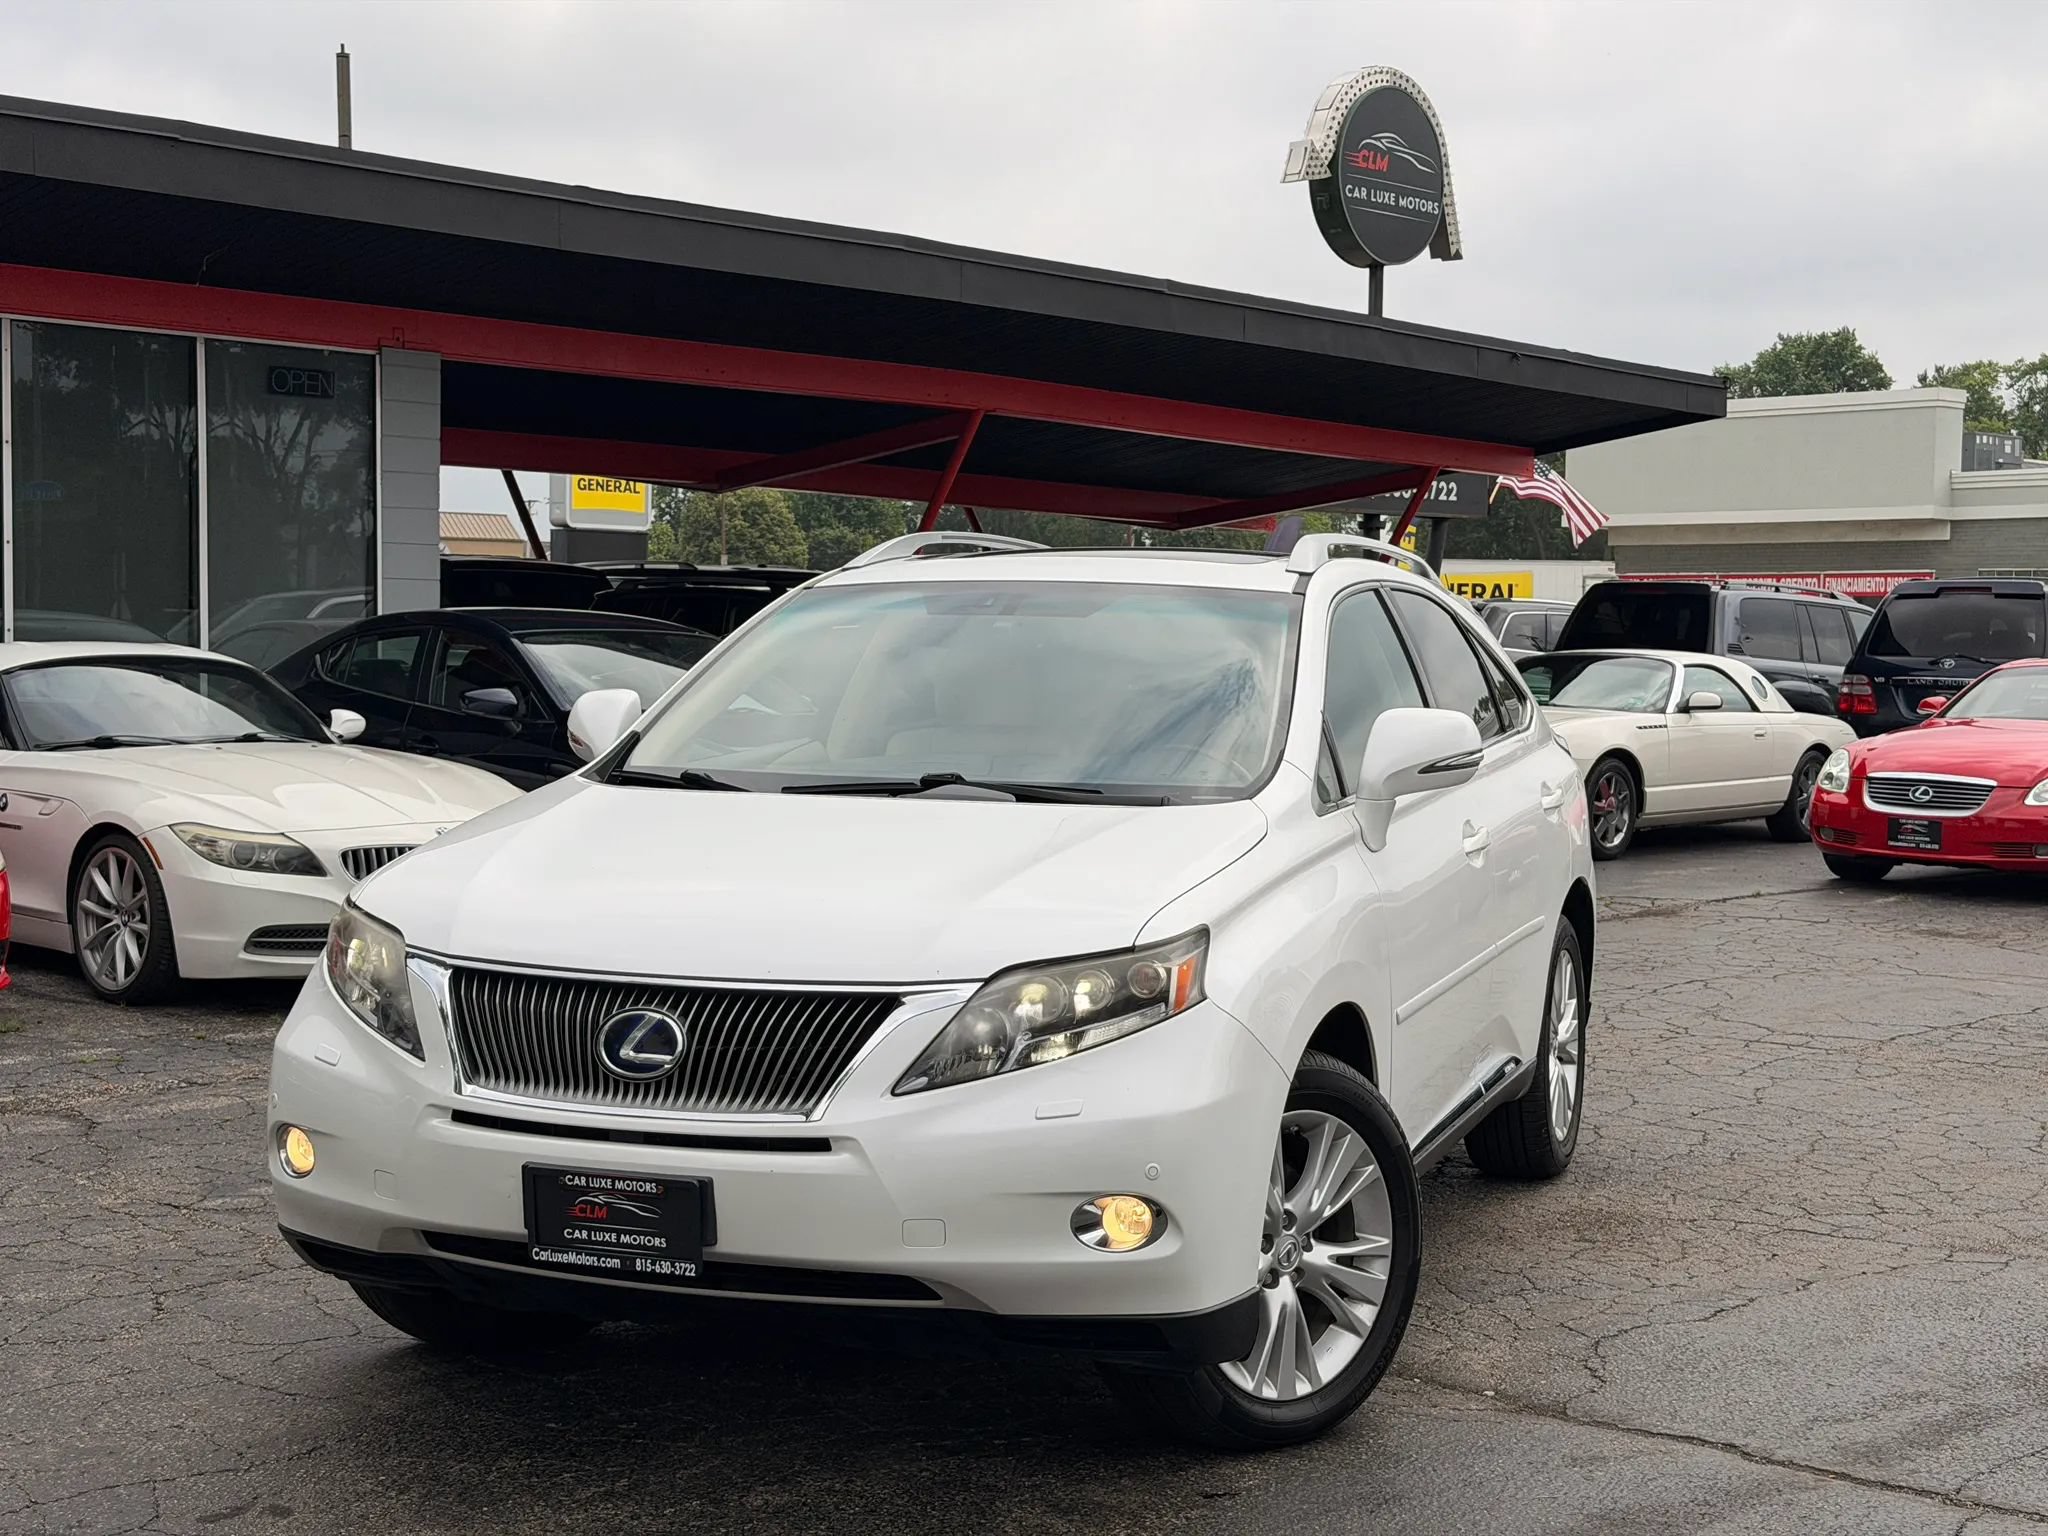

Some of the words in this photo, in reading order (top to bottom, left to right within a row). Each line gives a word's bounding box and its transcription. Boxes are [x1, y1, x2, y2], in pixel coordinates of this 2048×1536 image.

[1359, 149, 1390, 173] CLM
[1345, 184, 1368, 201] CAR
[1370, 188, 1396, 206] LUXE
[1398, 194, 1440, 215] MOTORS
[272, 368, 334, 396] OPEN
[577, 477, 641, 494] GENERAL
[1825, 577, 1885, 593] FINANCIAMIENTO
[565, 1174, 587, 1187] CAR
[588, 1176, 613, 1189] LUXE
[614, 1179, 657, 1193] MOTORS
[575, 1204, 608, 1219] CLM
[563, 1228, 588, 1240] CAR
[591, 1230, 617, 1243] LUXE
[619, 1233, 667, 1248] MOTORS
[532, 1247, 621, 1269] CarLuxeMotors.com
[635, 1257, 696, 1277] 815-630-3722
